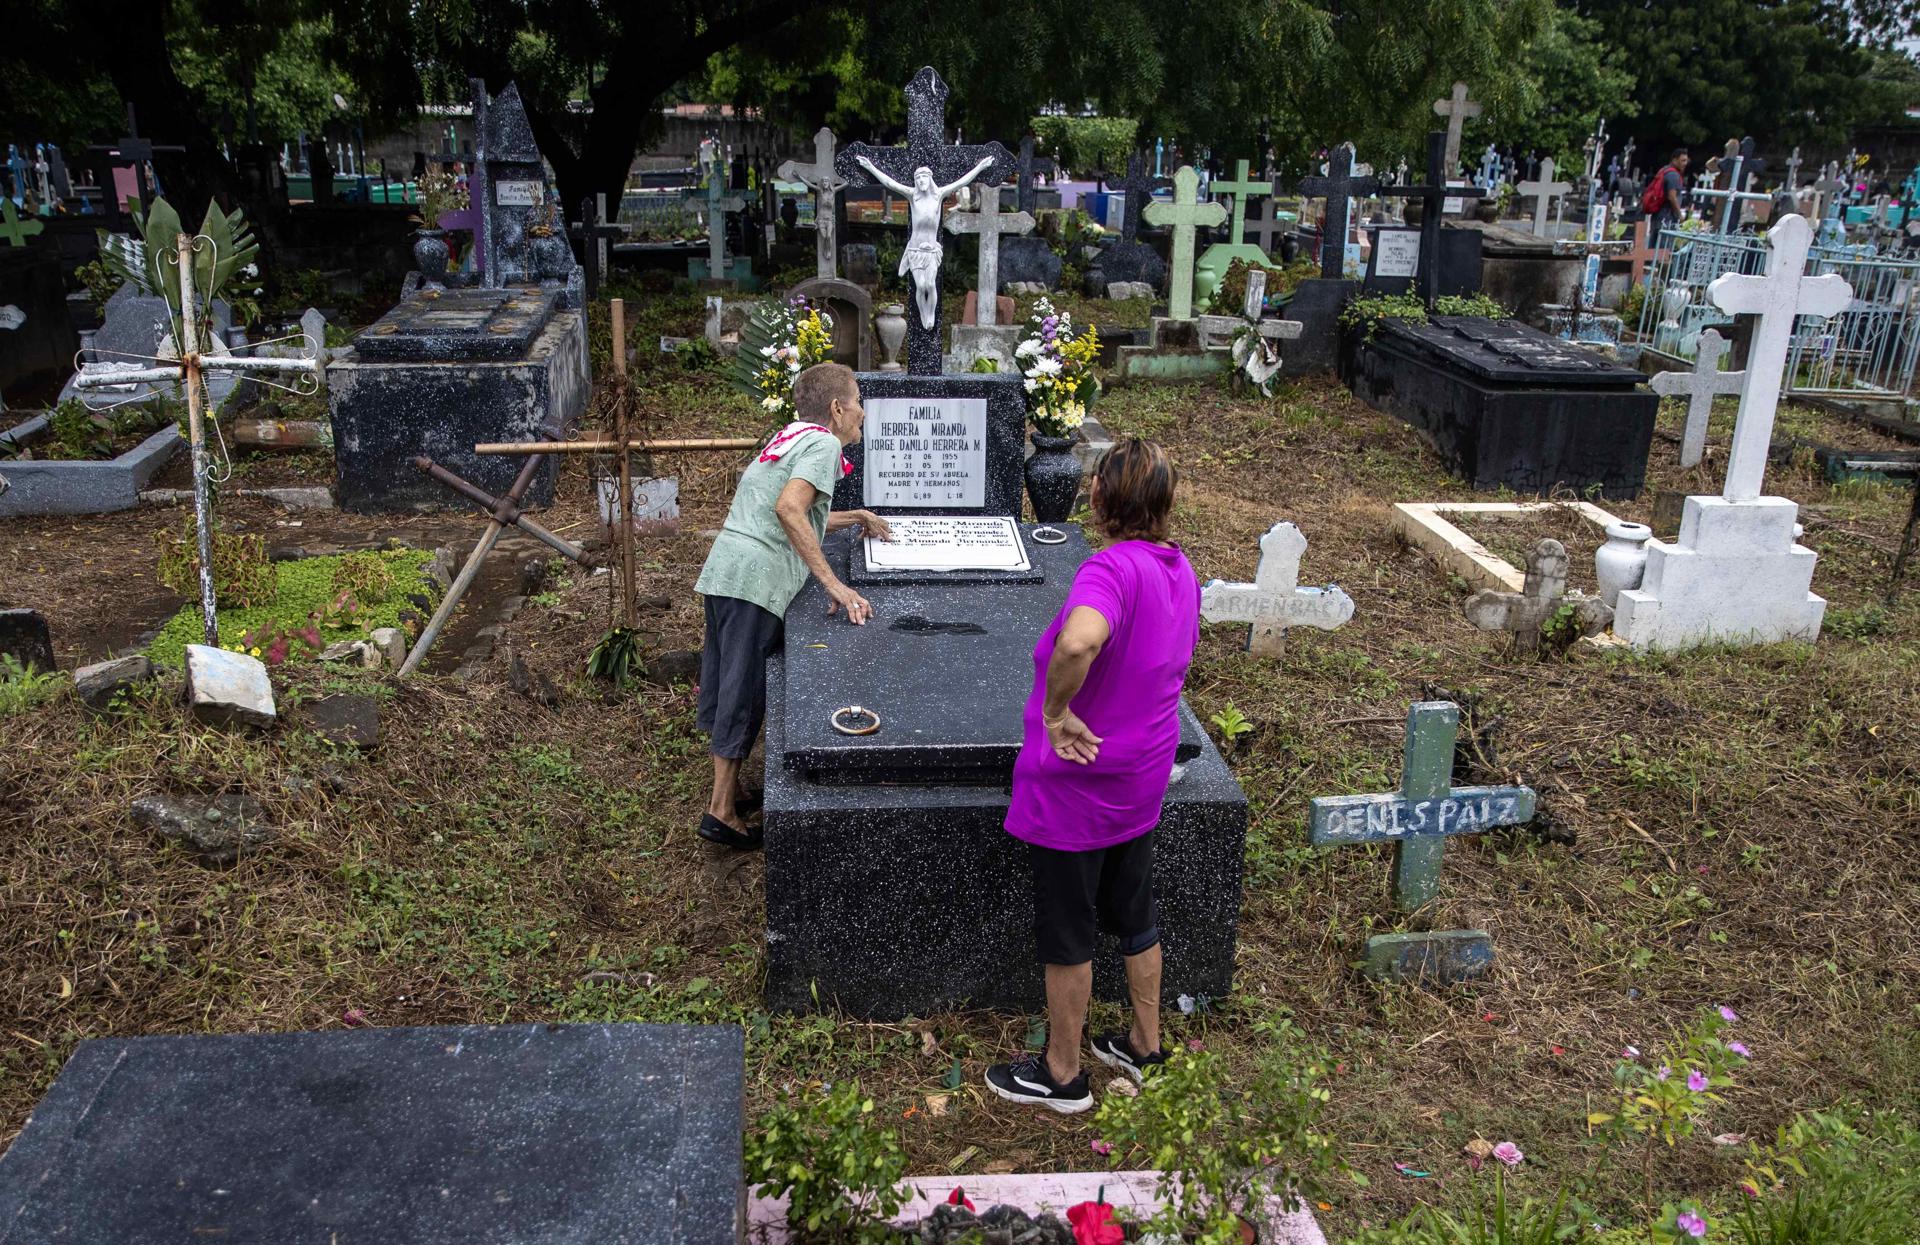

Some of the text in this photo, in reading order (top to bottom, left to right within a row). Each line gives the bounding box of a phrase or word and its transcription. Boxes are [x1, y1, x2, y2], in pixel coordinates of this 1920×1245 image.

[909, 406, 941, 420] FAMILIA
[881, 422, 967, 436] HERRERA MIRANDA
[869, 439, 895, 451] JORGE
[899, 439, 928, 451] DANILO
[933, 440, 969, 451] HERRERA
[1211, 595, 1288, 616] ARMEN
[1326, 796, 1520, 836] DENIS PAIZ
